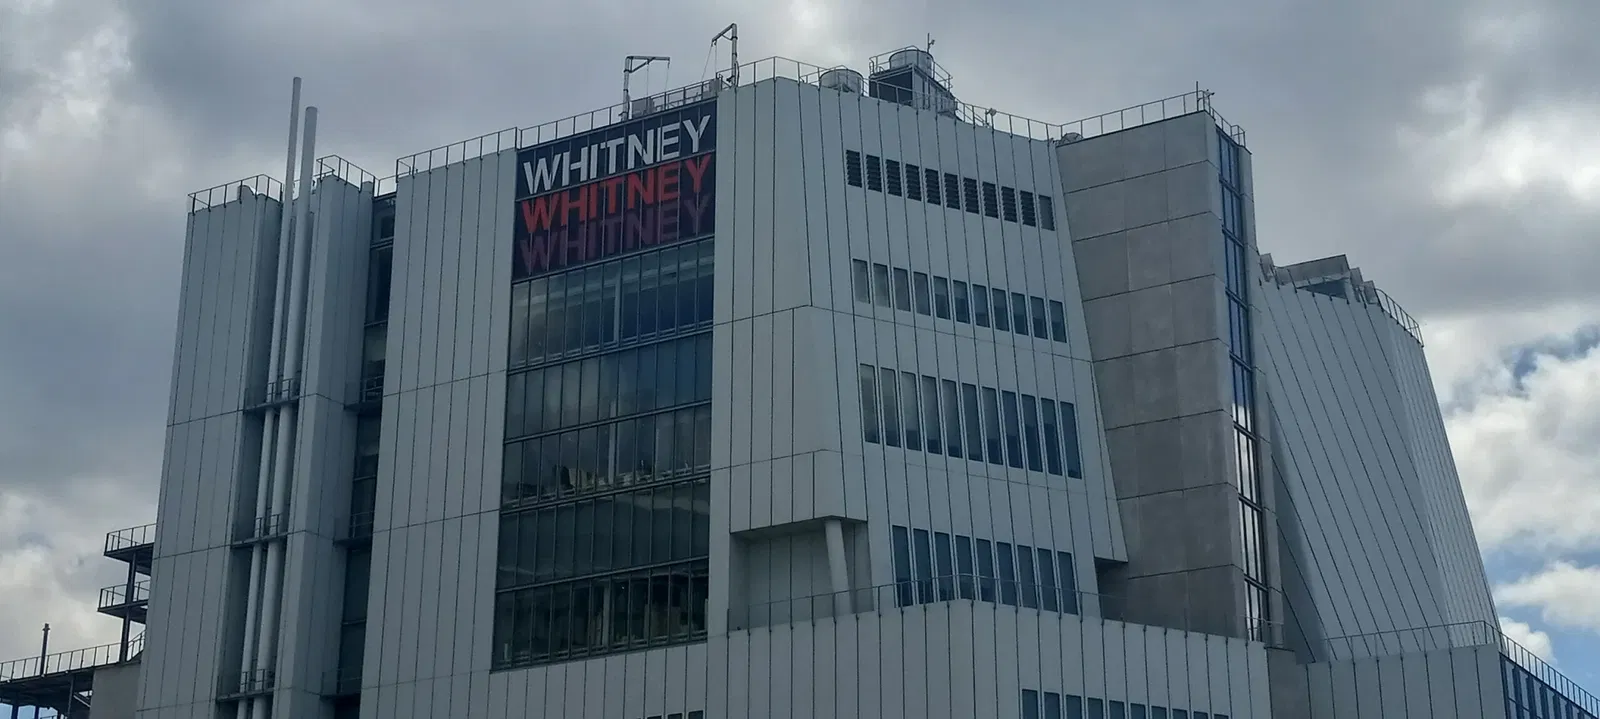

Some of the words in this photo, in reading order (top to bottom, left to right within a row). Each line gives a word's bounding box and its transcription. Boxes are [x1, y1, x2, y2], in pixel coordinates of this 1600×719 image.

[521, 154, 712, 234] WHITNEY
[523, 115, 711, 195] WHITNEY
[520, 194, 710, 274] WHITNEY
